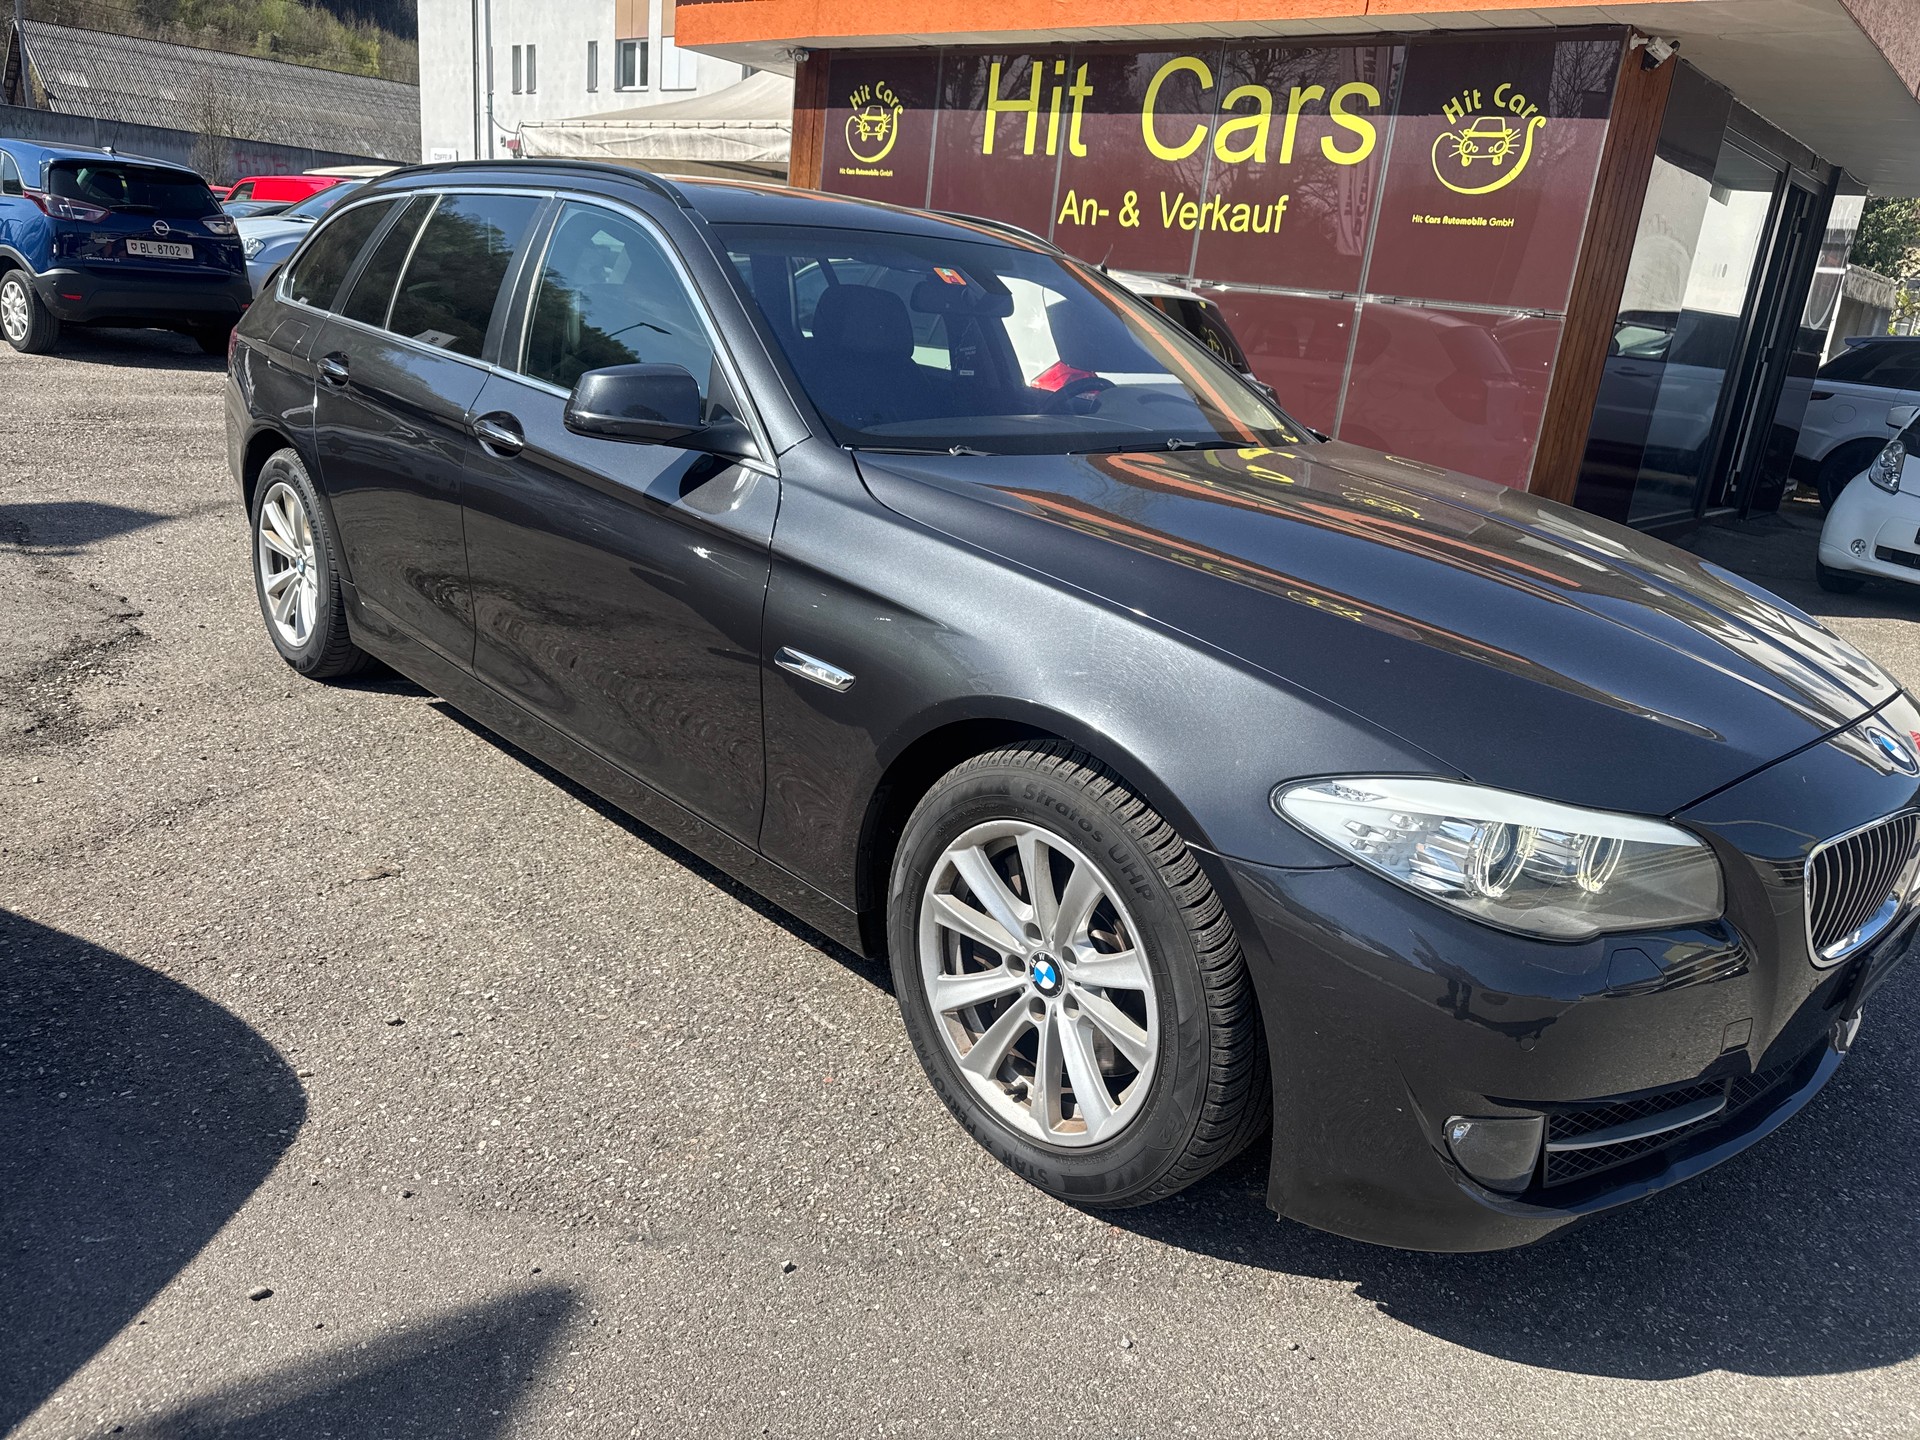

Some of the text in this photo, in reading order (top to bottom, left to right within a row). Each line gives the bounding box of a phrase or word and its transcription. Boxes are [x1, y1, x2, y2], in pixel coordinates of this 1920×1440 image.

[849, 85, 871, 111] Hit
[983, 56, 1381, 165] Hit Cars
[1442, 89, 1482, 125] Hit
[1057, 189, 1290, 234] An- & Verkauf
[1411, 214, 1515, 227] Hit Cars Automobile GmbH
[140, 243, 182, 256] BL 8702
[293, 474, 312, 516] Stratos
[1023, 783, 1104, 843] Stratos
[1108, 843, 1156, 902] UHP
[1001, 1149, 1049, 1186] STAR
